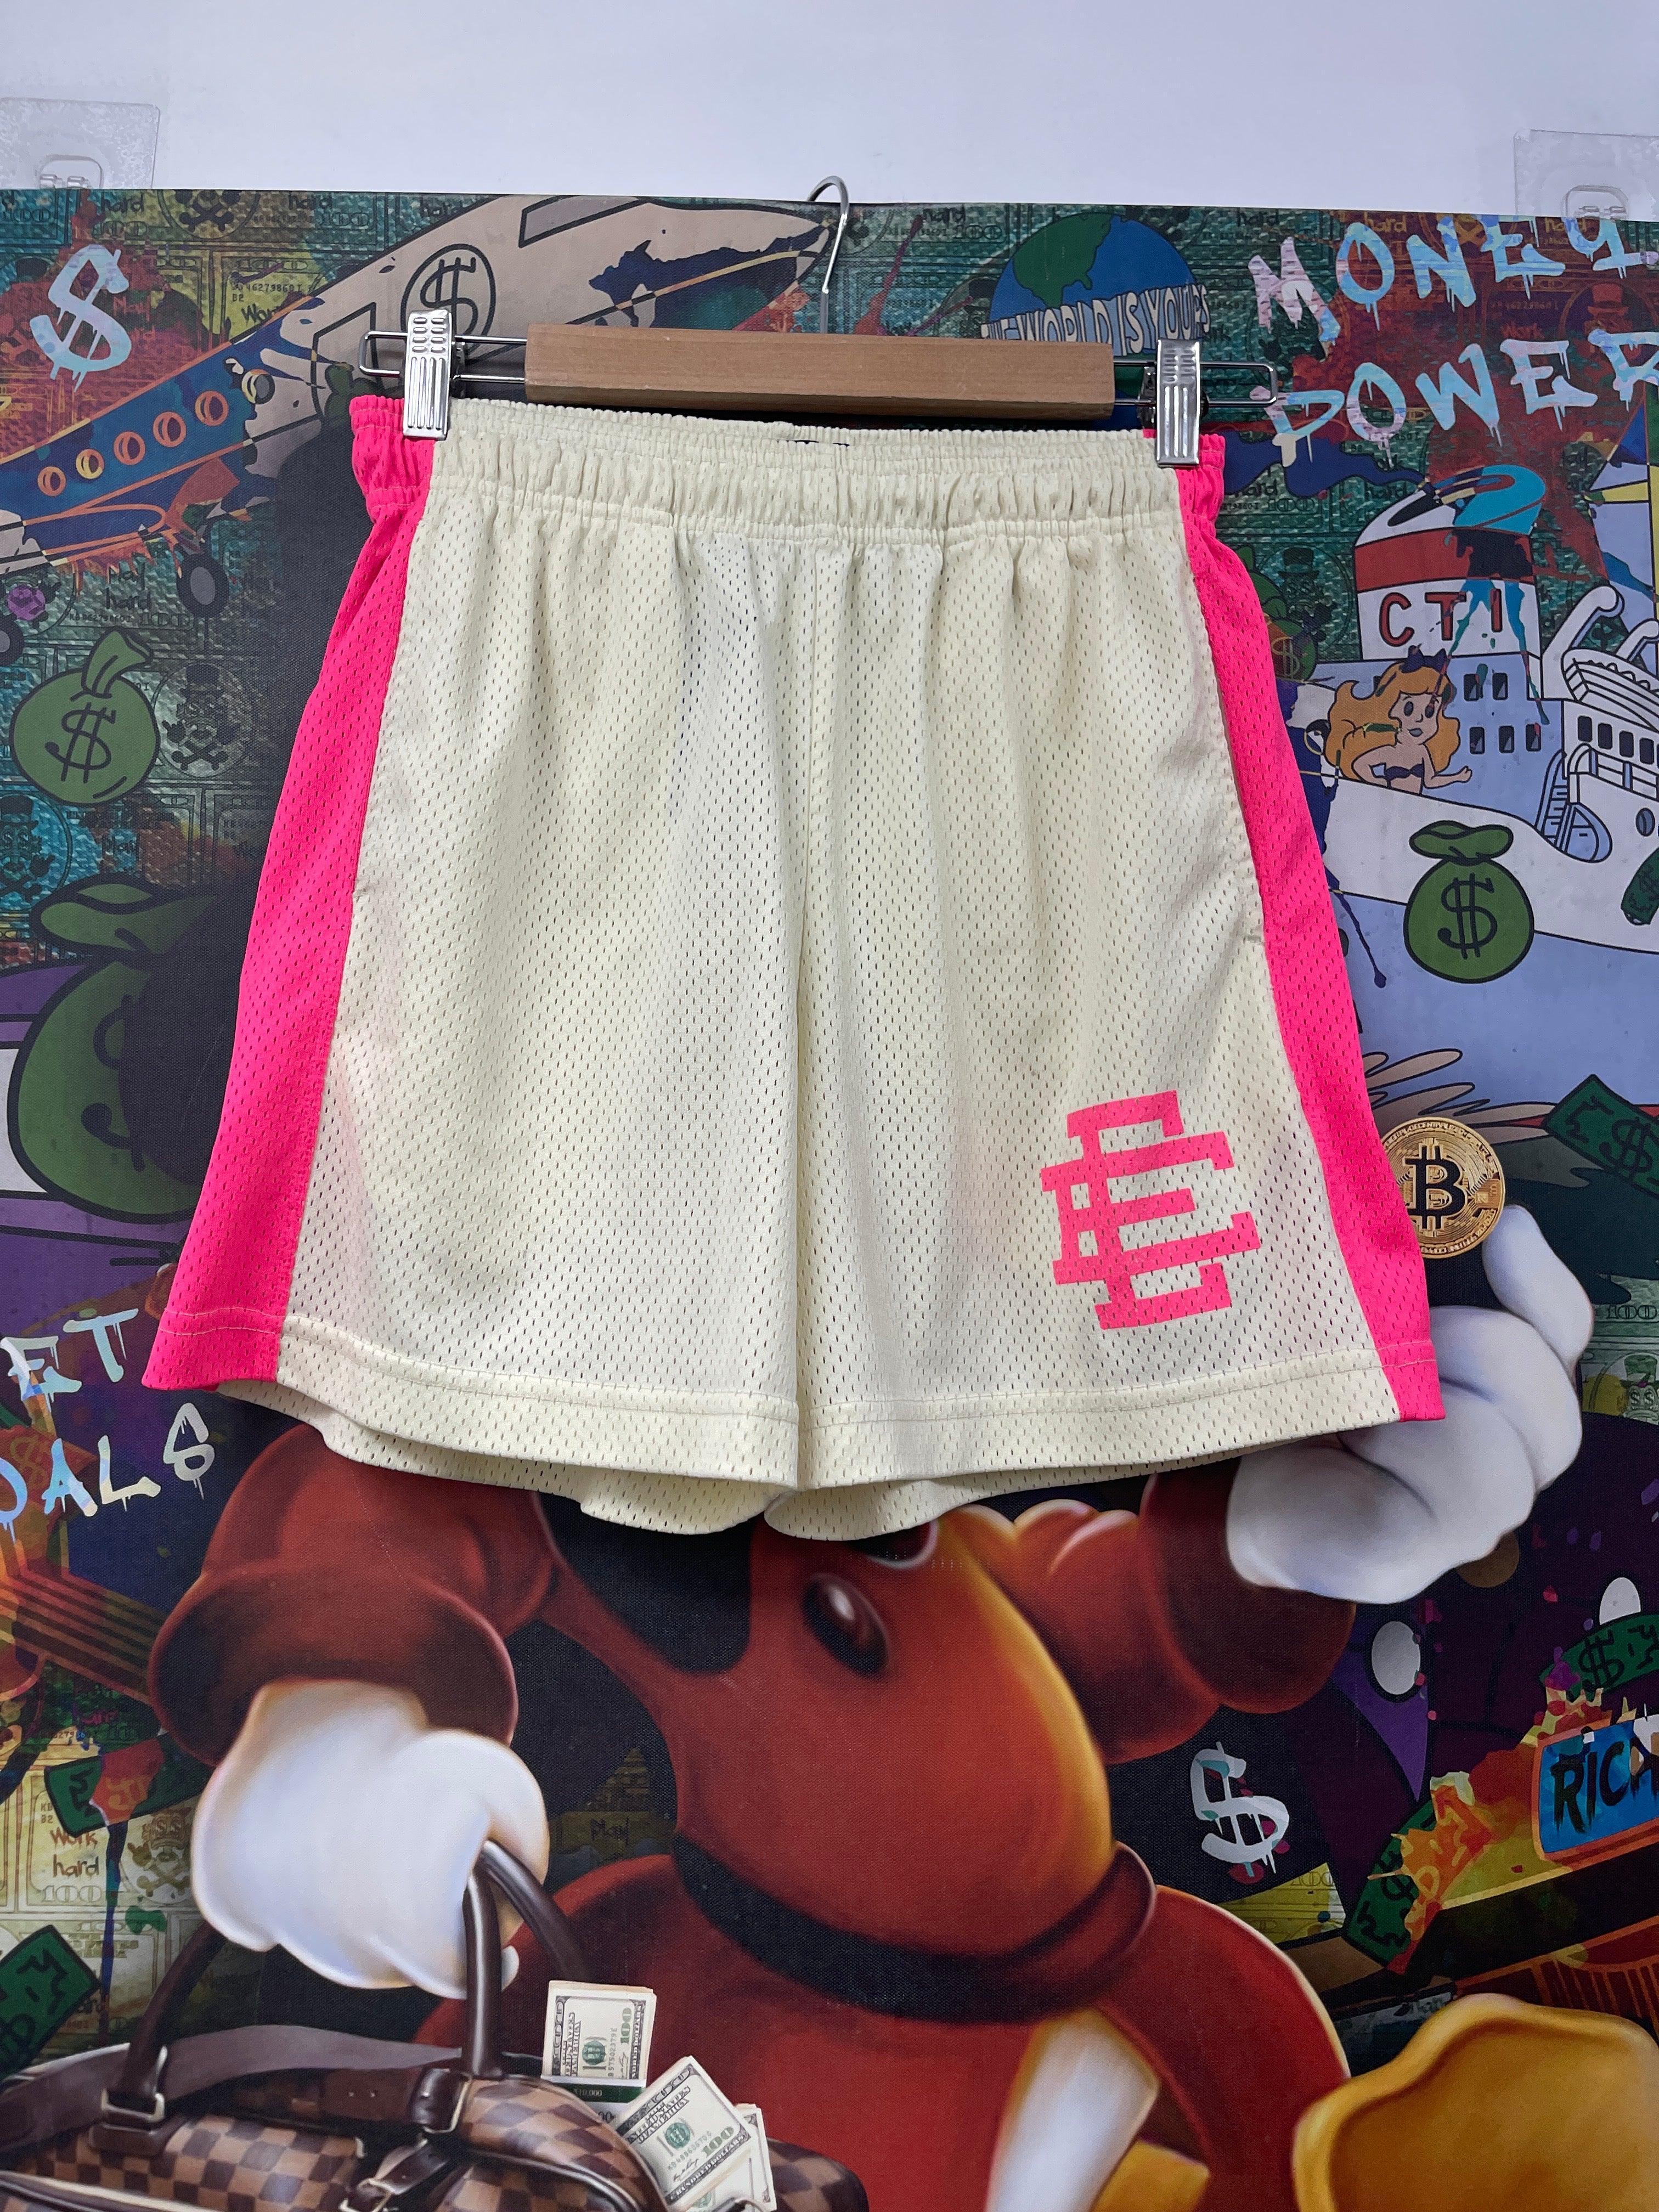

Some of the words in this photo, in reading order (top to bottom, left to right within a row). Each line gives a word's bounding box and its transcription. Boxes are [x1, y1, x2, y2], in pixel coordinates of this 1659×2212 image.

[241, 303, 277, 325] Wor
[1116, 292, 1144, 356] IS
[1378, 587, 1502, 647] CTI
[53, 1854, 99, 1877] hard
[42, 1885, 102, 1903] 100
[620, 2007, 631, 2045] 100
[702, 2126, 735, 2157] 100
